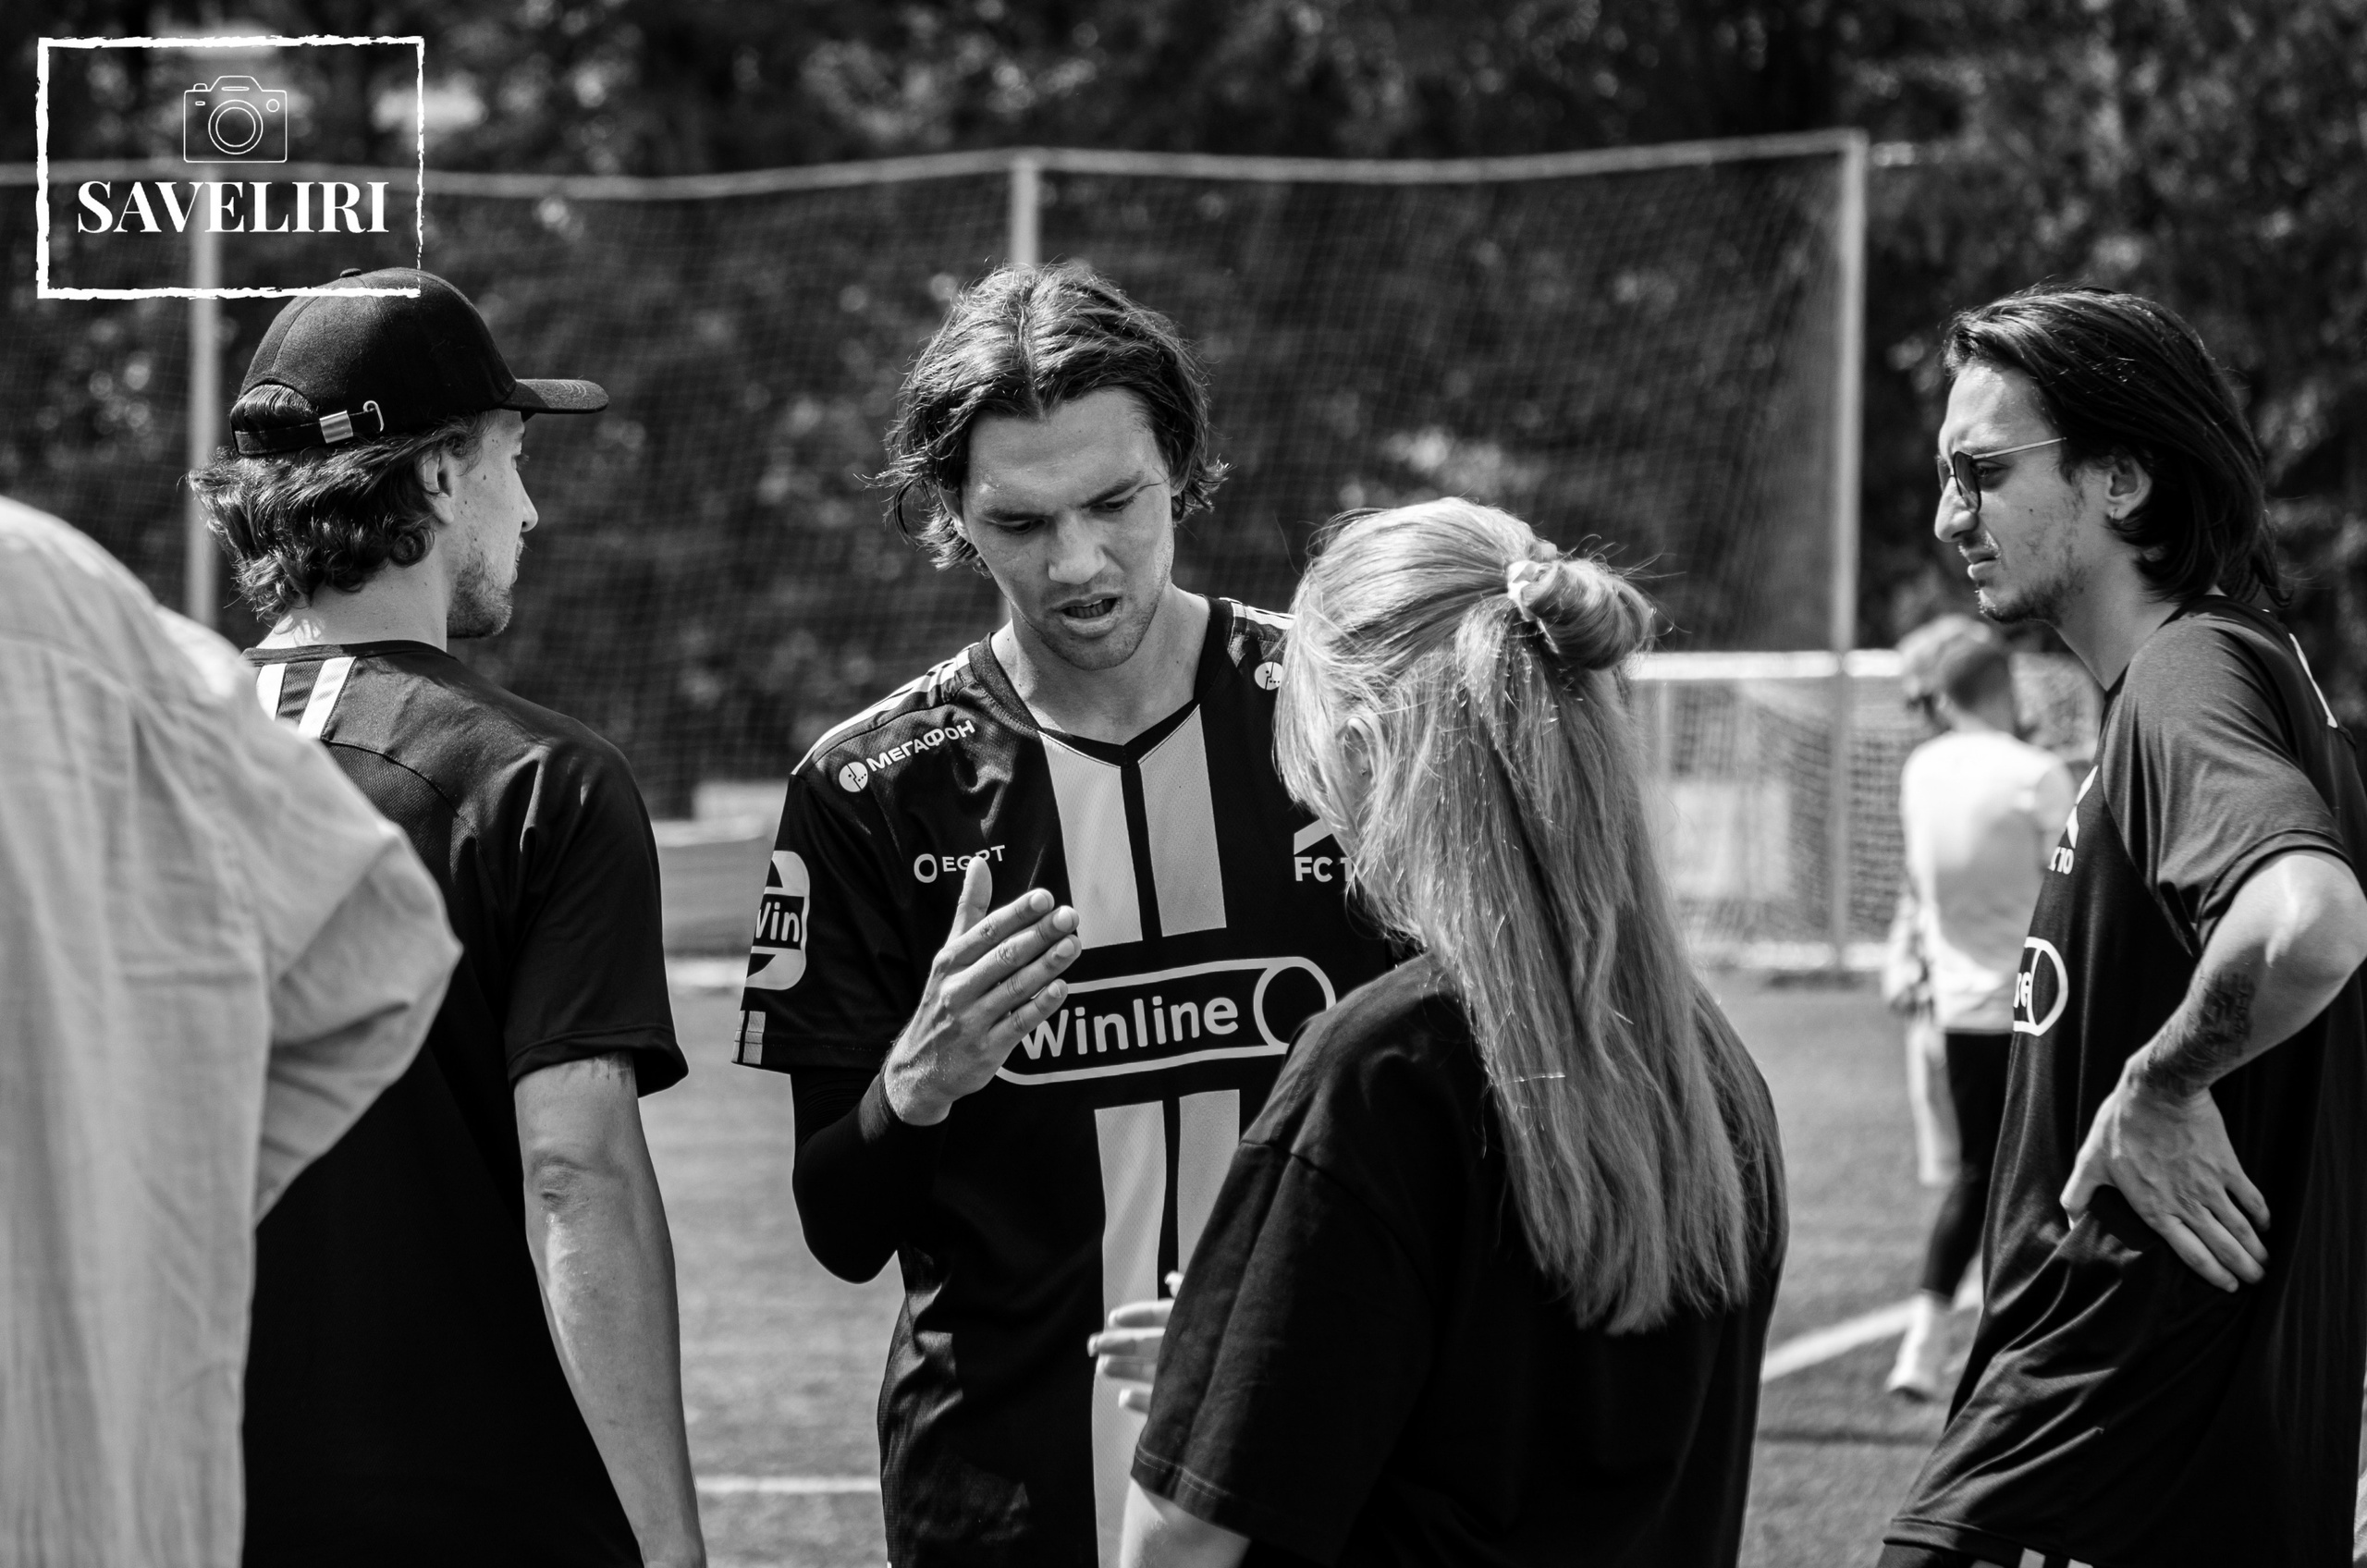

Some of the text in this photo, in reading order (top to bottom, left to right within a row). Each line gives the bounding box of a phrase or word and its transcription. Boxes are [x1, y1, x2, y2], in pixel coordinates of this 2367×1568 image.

[865, 719, 975, 772] МЕГАФОН
[1294, 856, 1333, 883] FC
[1021, 995, 1239, 1060] Winline
